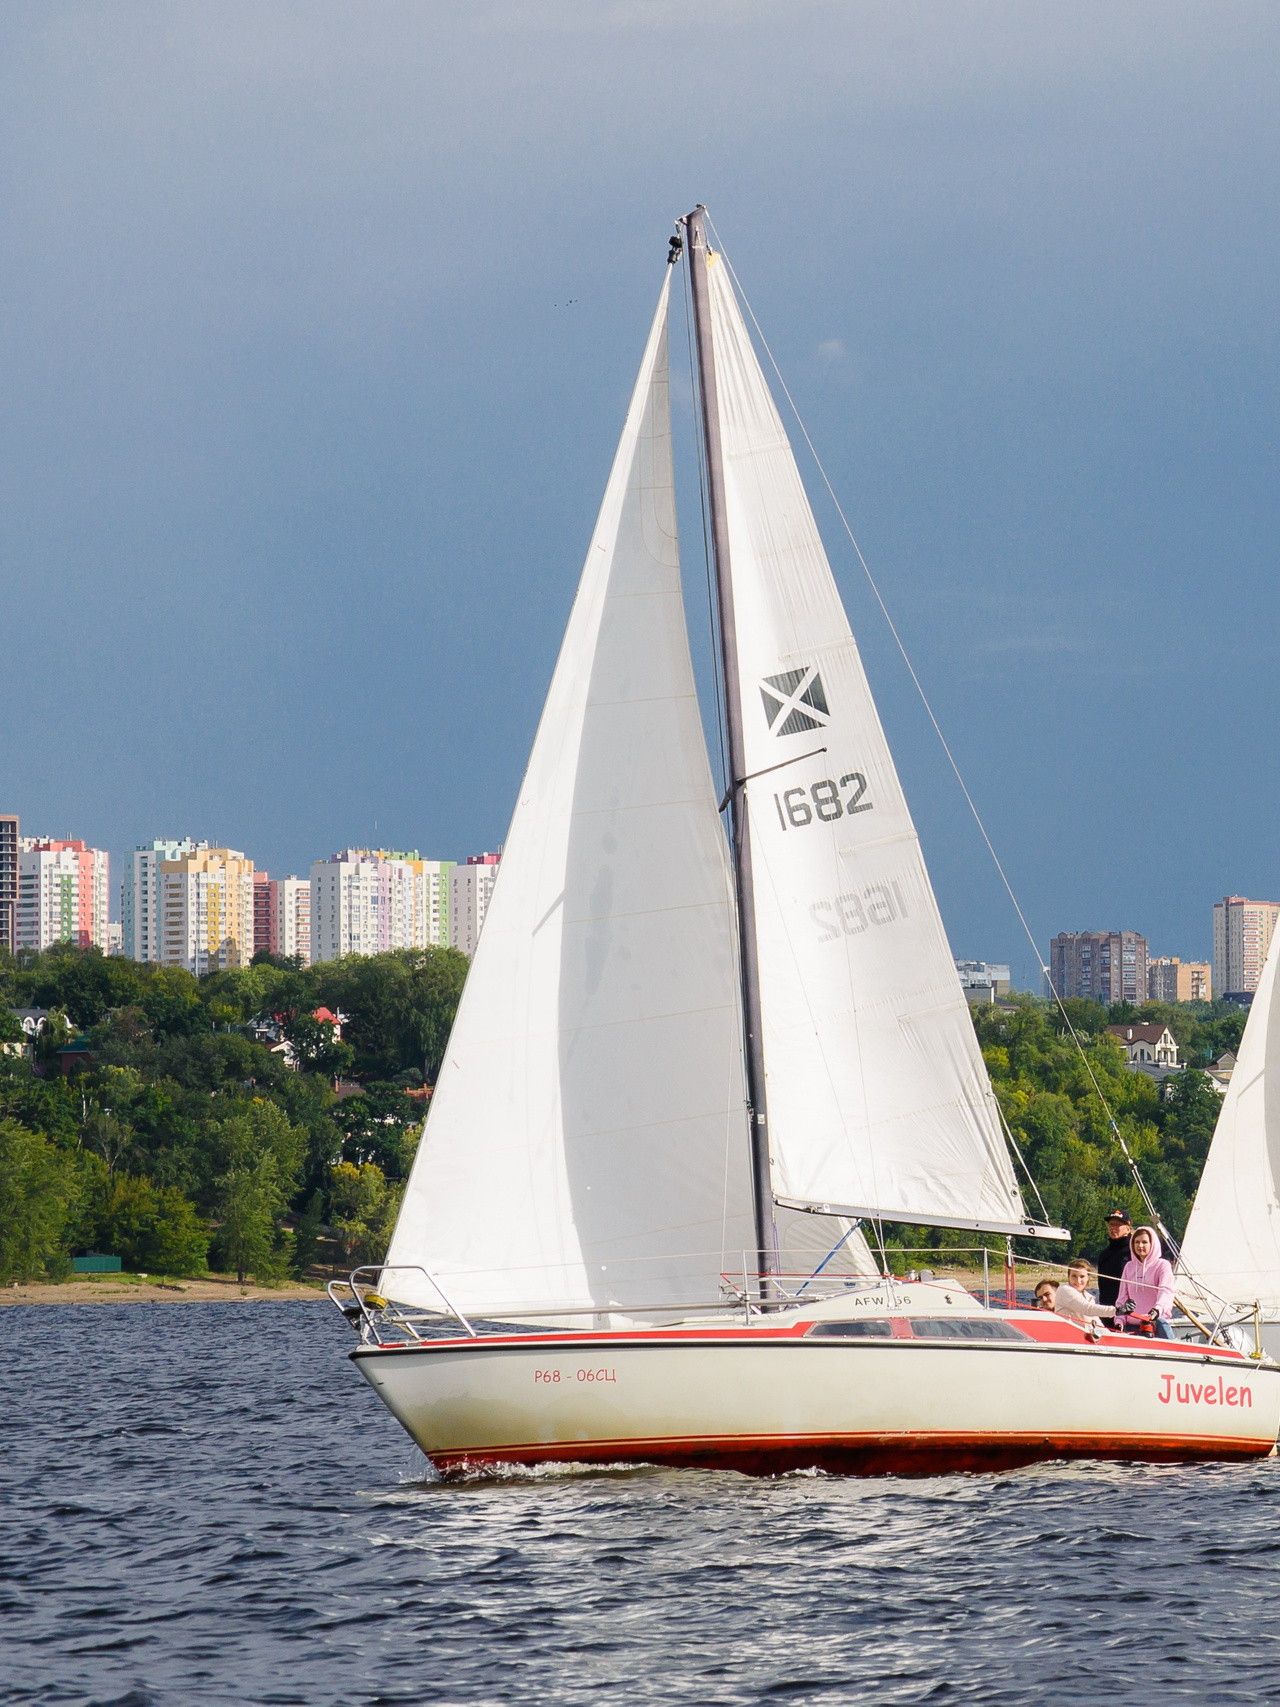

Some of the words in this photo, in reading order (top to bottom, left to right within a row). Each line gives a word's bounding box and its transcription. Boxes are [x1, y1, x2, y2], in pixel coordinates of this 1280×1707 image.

[773, 771, 874, 832] 1682
[854, 1296, 884, 1306] AFW
[1158, 1373, 1252, 1408] Juvelen
